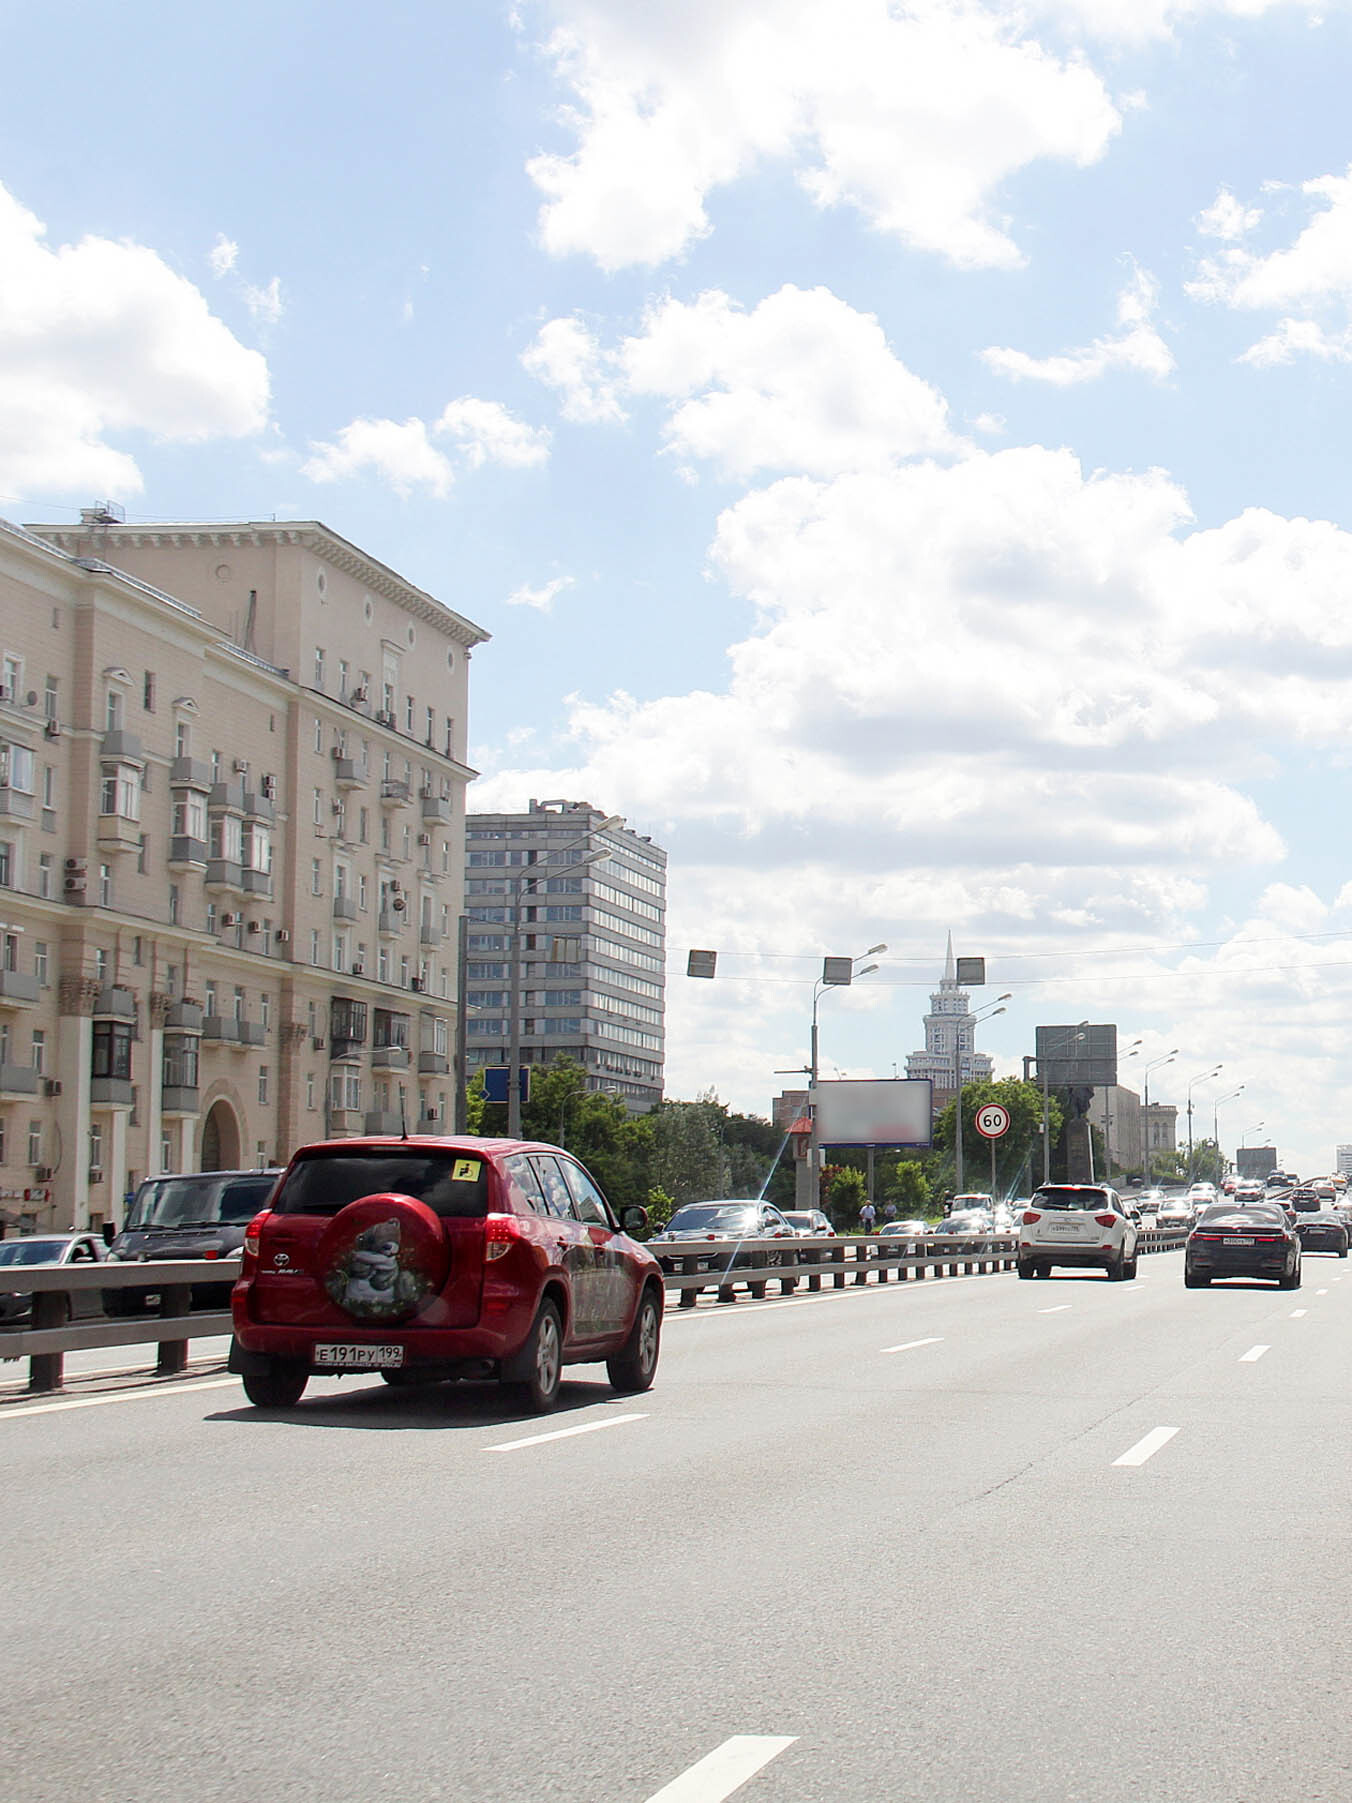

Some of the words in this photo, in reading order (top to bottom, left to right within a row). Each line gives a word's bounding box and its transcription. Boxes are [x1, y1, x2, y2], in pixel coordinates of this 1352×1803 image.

[983, 1114, 1002, 1127] 60
[319, 1346, 376, 1361] Е191РУ
[379, 1347, 400, 1358] 199
